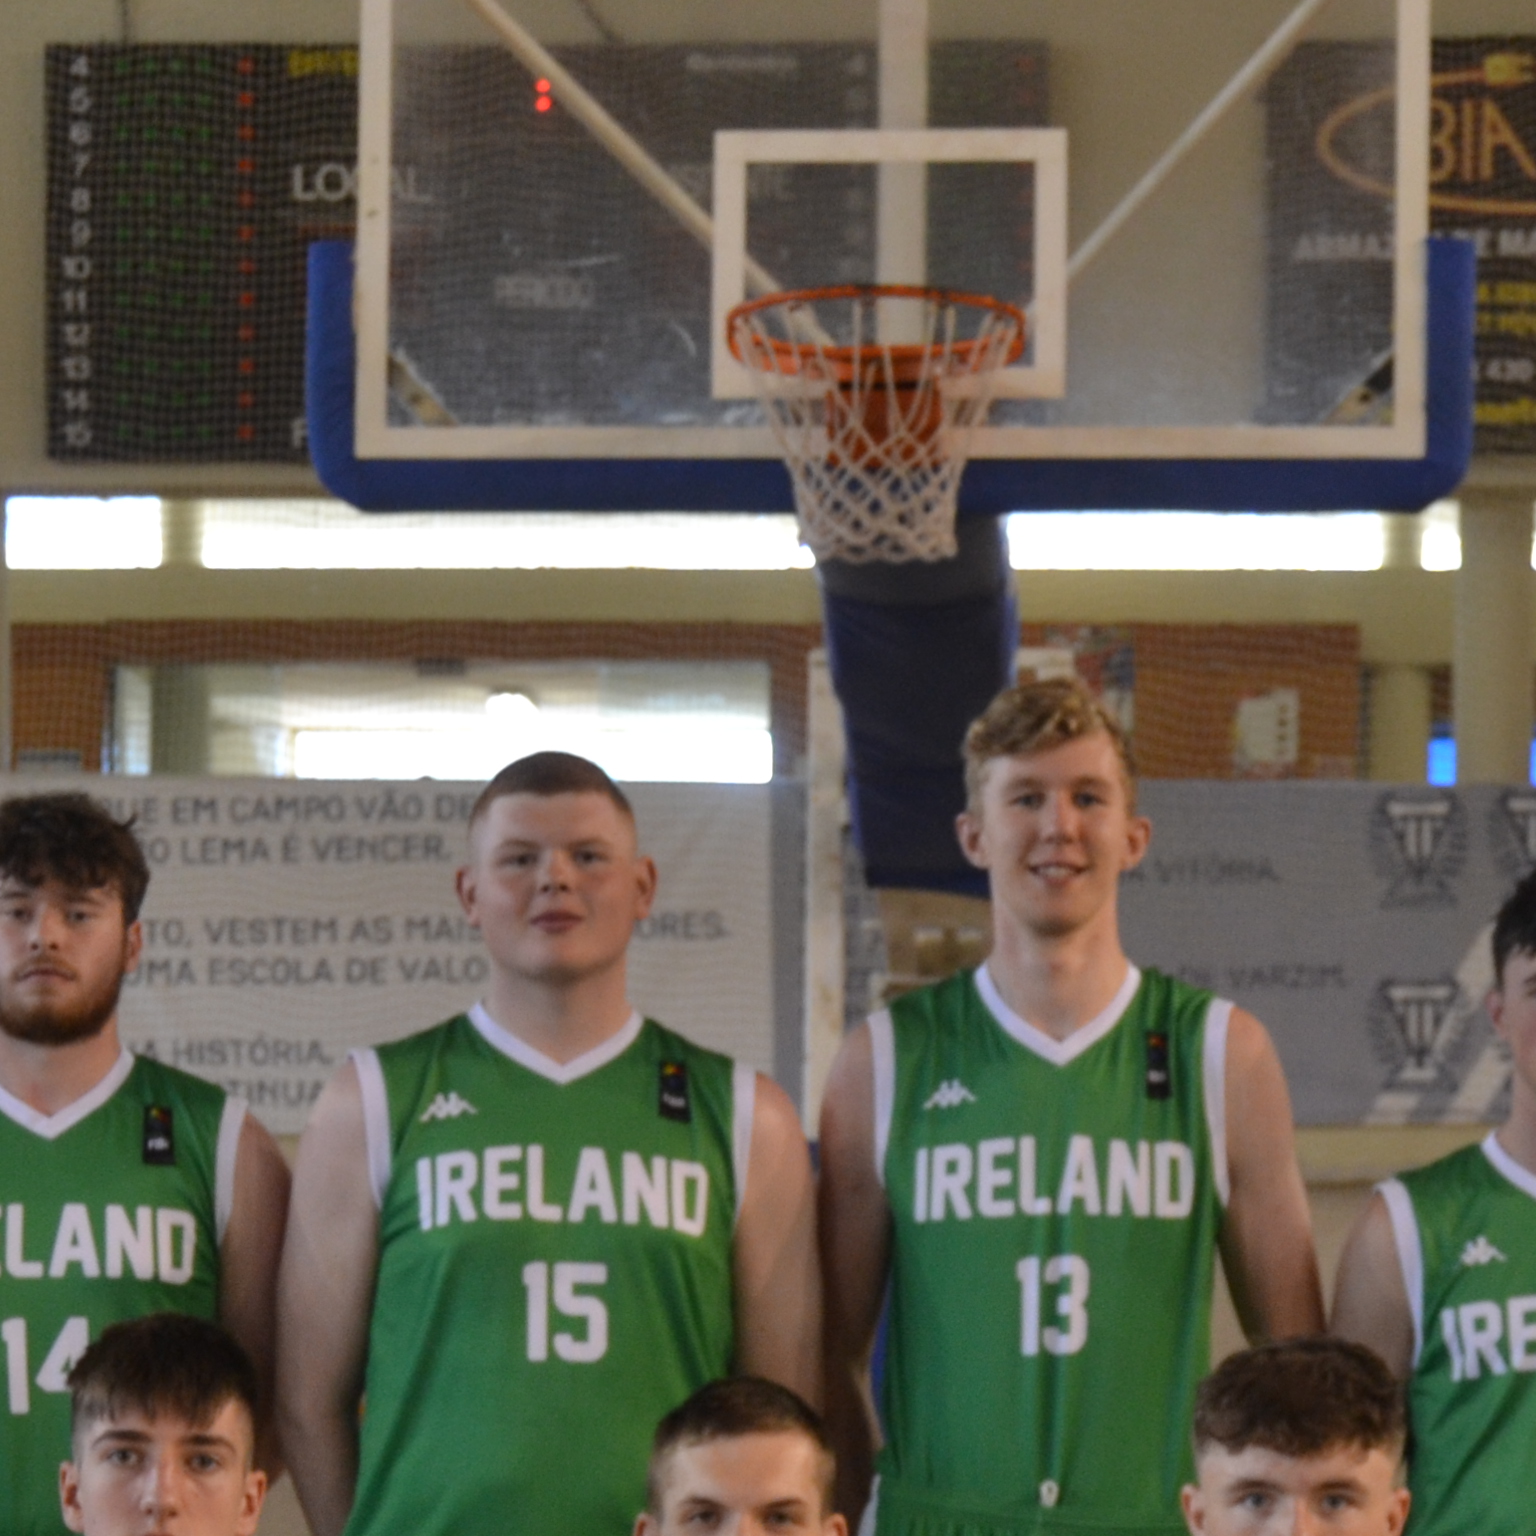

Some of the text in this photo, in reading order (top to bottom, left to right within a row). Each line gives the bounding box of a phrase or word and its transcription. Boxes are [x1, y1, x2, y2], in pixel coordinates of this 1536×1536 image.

[69, 55, 89, 77] 4
[73, 153, 91, 178] 7
[291, 162, 434, 203] LOAL
[61, 288, 87, 313] 11
[171, 796, 219, 825] EM
[228, 797, 348, 825] CAMPO
[358, 791, 424, 824] VÃO
[181, 836, 267, 864] LEMA
[280, 828, 302, 863] É
[314, 835, 452, 863] VENCER.
[204, 917, 336, 945] VESTEM
[353, 916, 396, 943] AS
[636, 912, 732, 941] ORES.
[208, 957, 333, 986] ESCOLA
[345, 956, 387, 984] DE
[397, 955, 489, 984] VALO
[416, 1143, 710, 1238] IRELAND
[913, 1134, 1196, 1224] IRELAND
[522, 1261, 608, 1363] 15
[1016, 1254, 1090, 1357] 13
